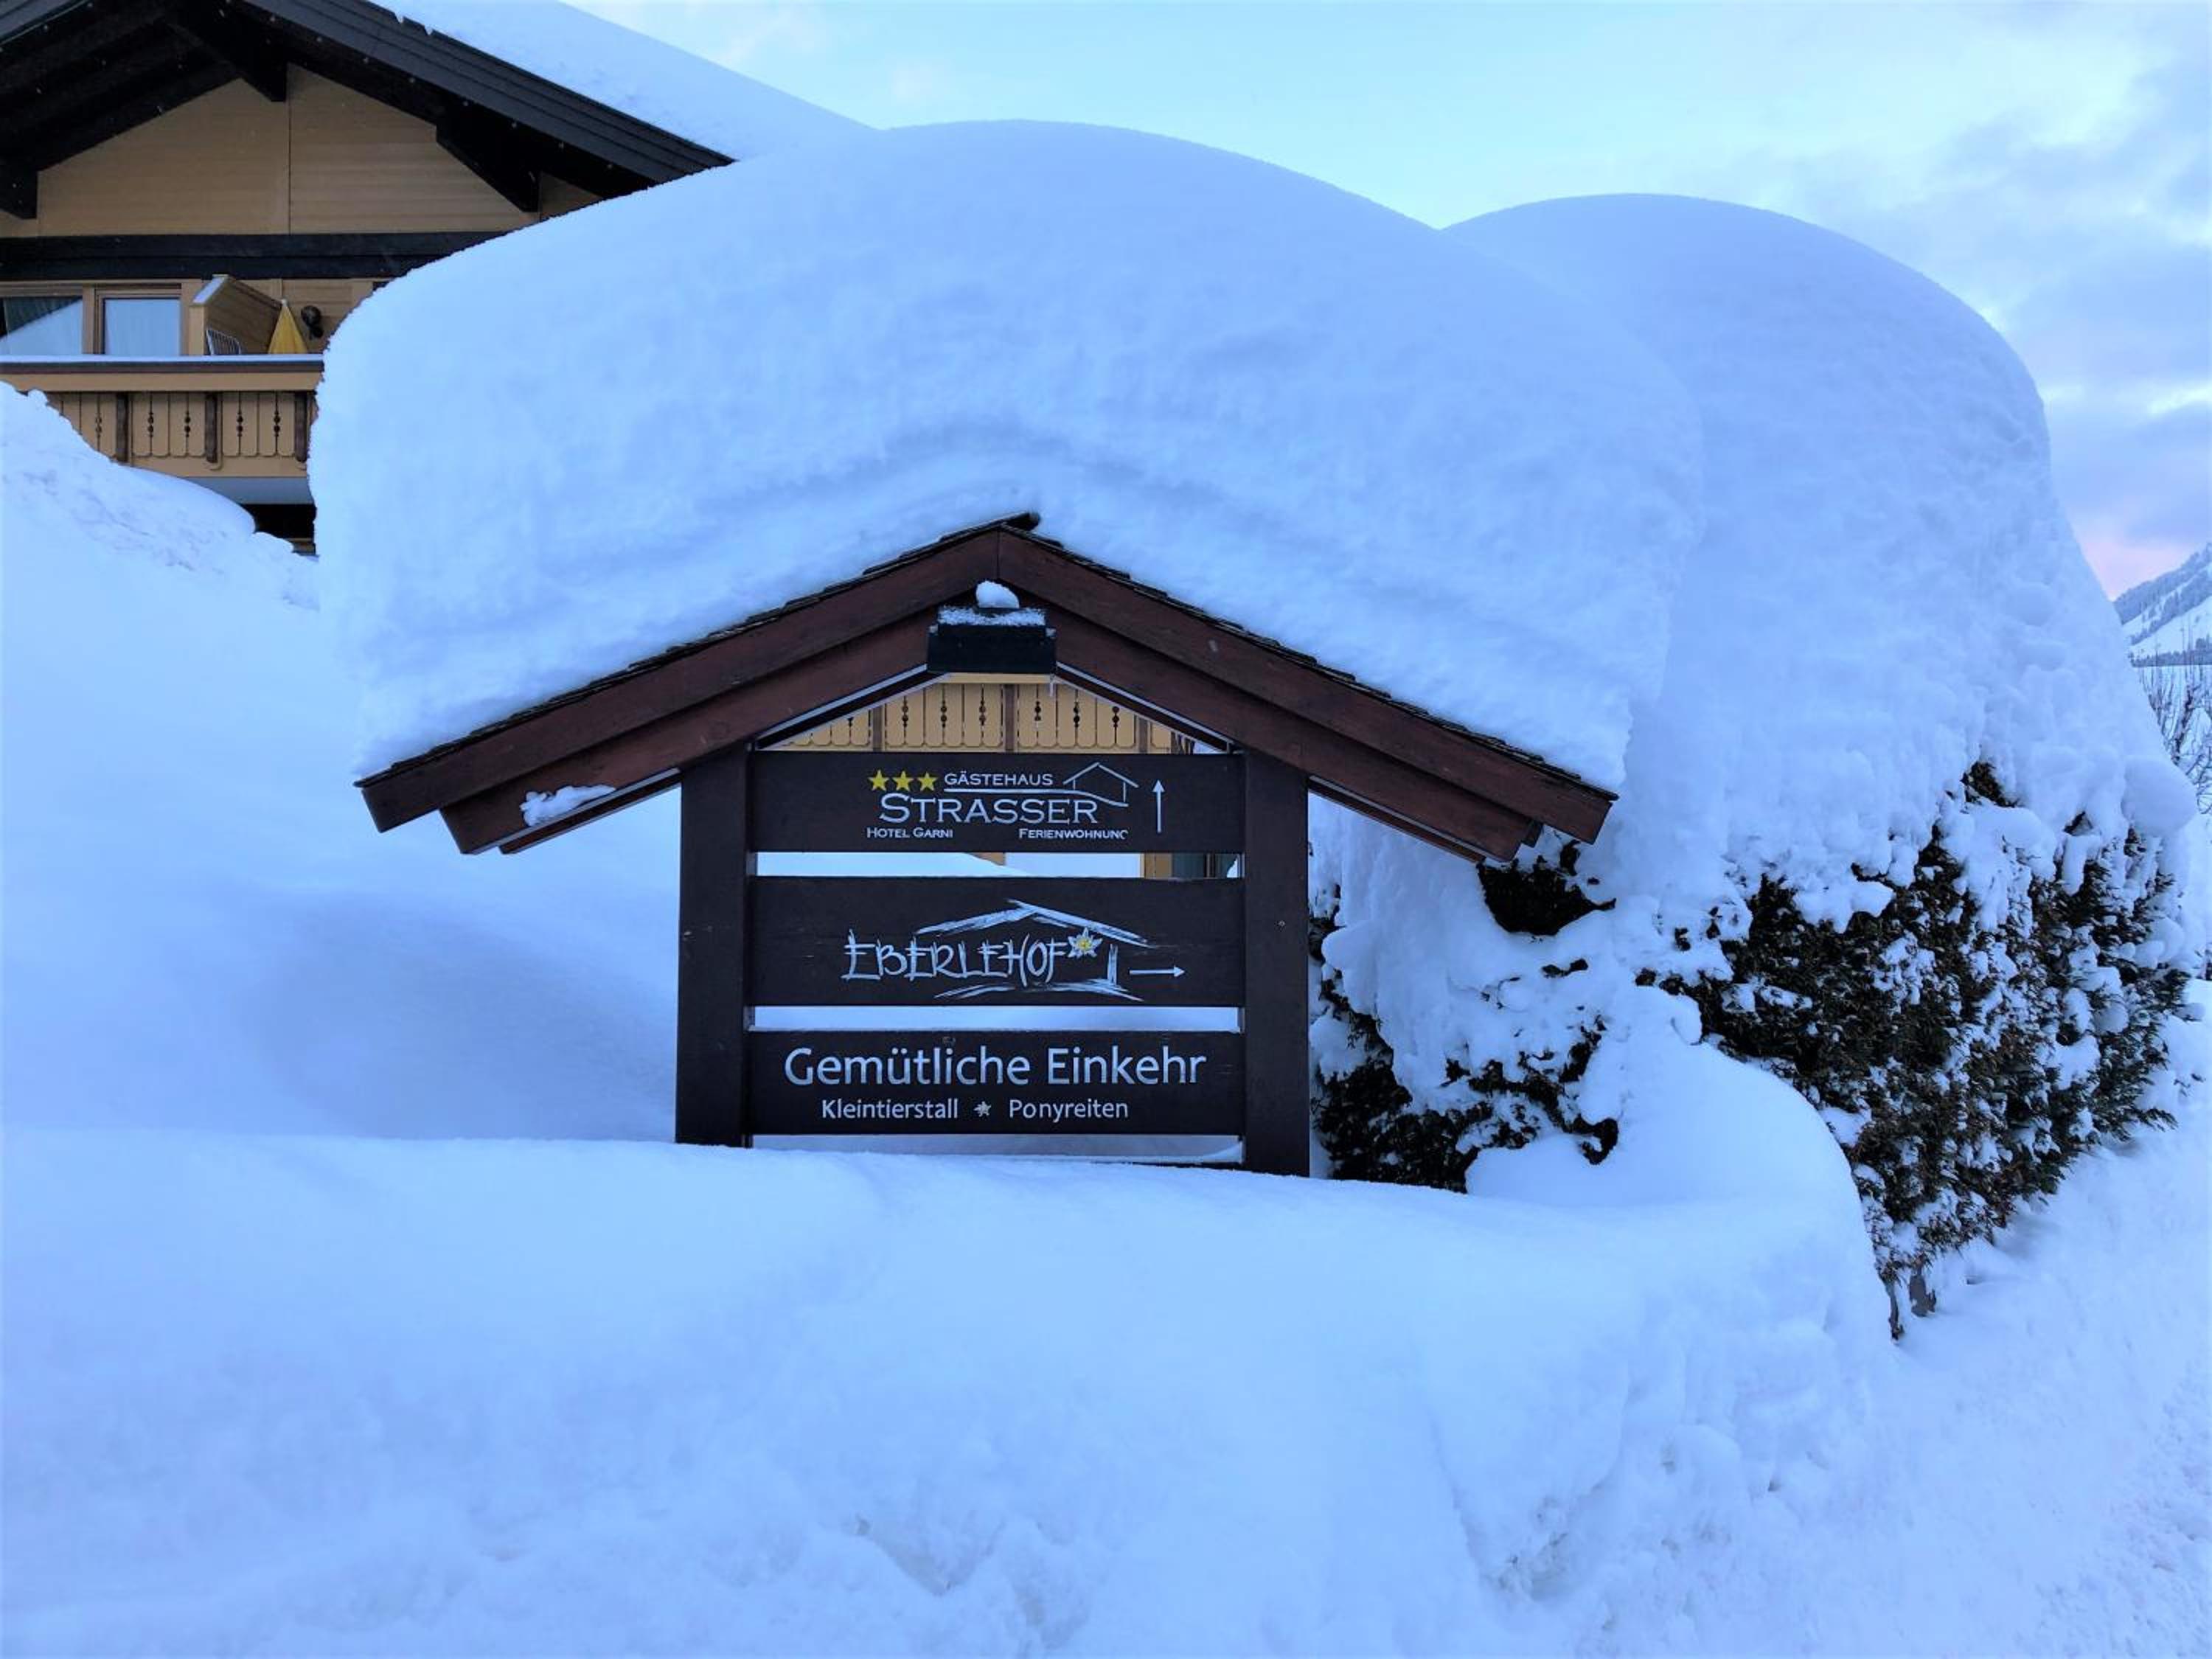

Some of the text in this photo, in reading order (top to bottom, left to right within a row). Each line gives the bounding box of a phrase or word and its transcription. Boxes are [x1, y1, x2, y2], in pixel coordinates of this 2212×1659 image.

[944, 770, 1054, 786] GÄSTEHAUS
[880, 793, 1098, 824] STRASSER
[841, 928, 1067, 987] EBERLEHOF
[784, 1046, 1207, 1086] Gemütliche Einkehr
[821, 1098, 1129, 1124] Kleintierstall Ponyreiten
